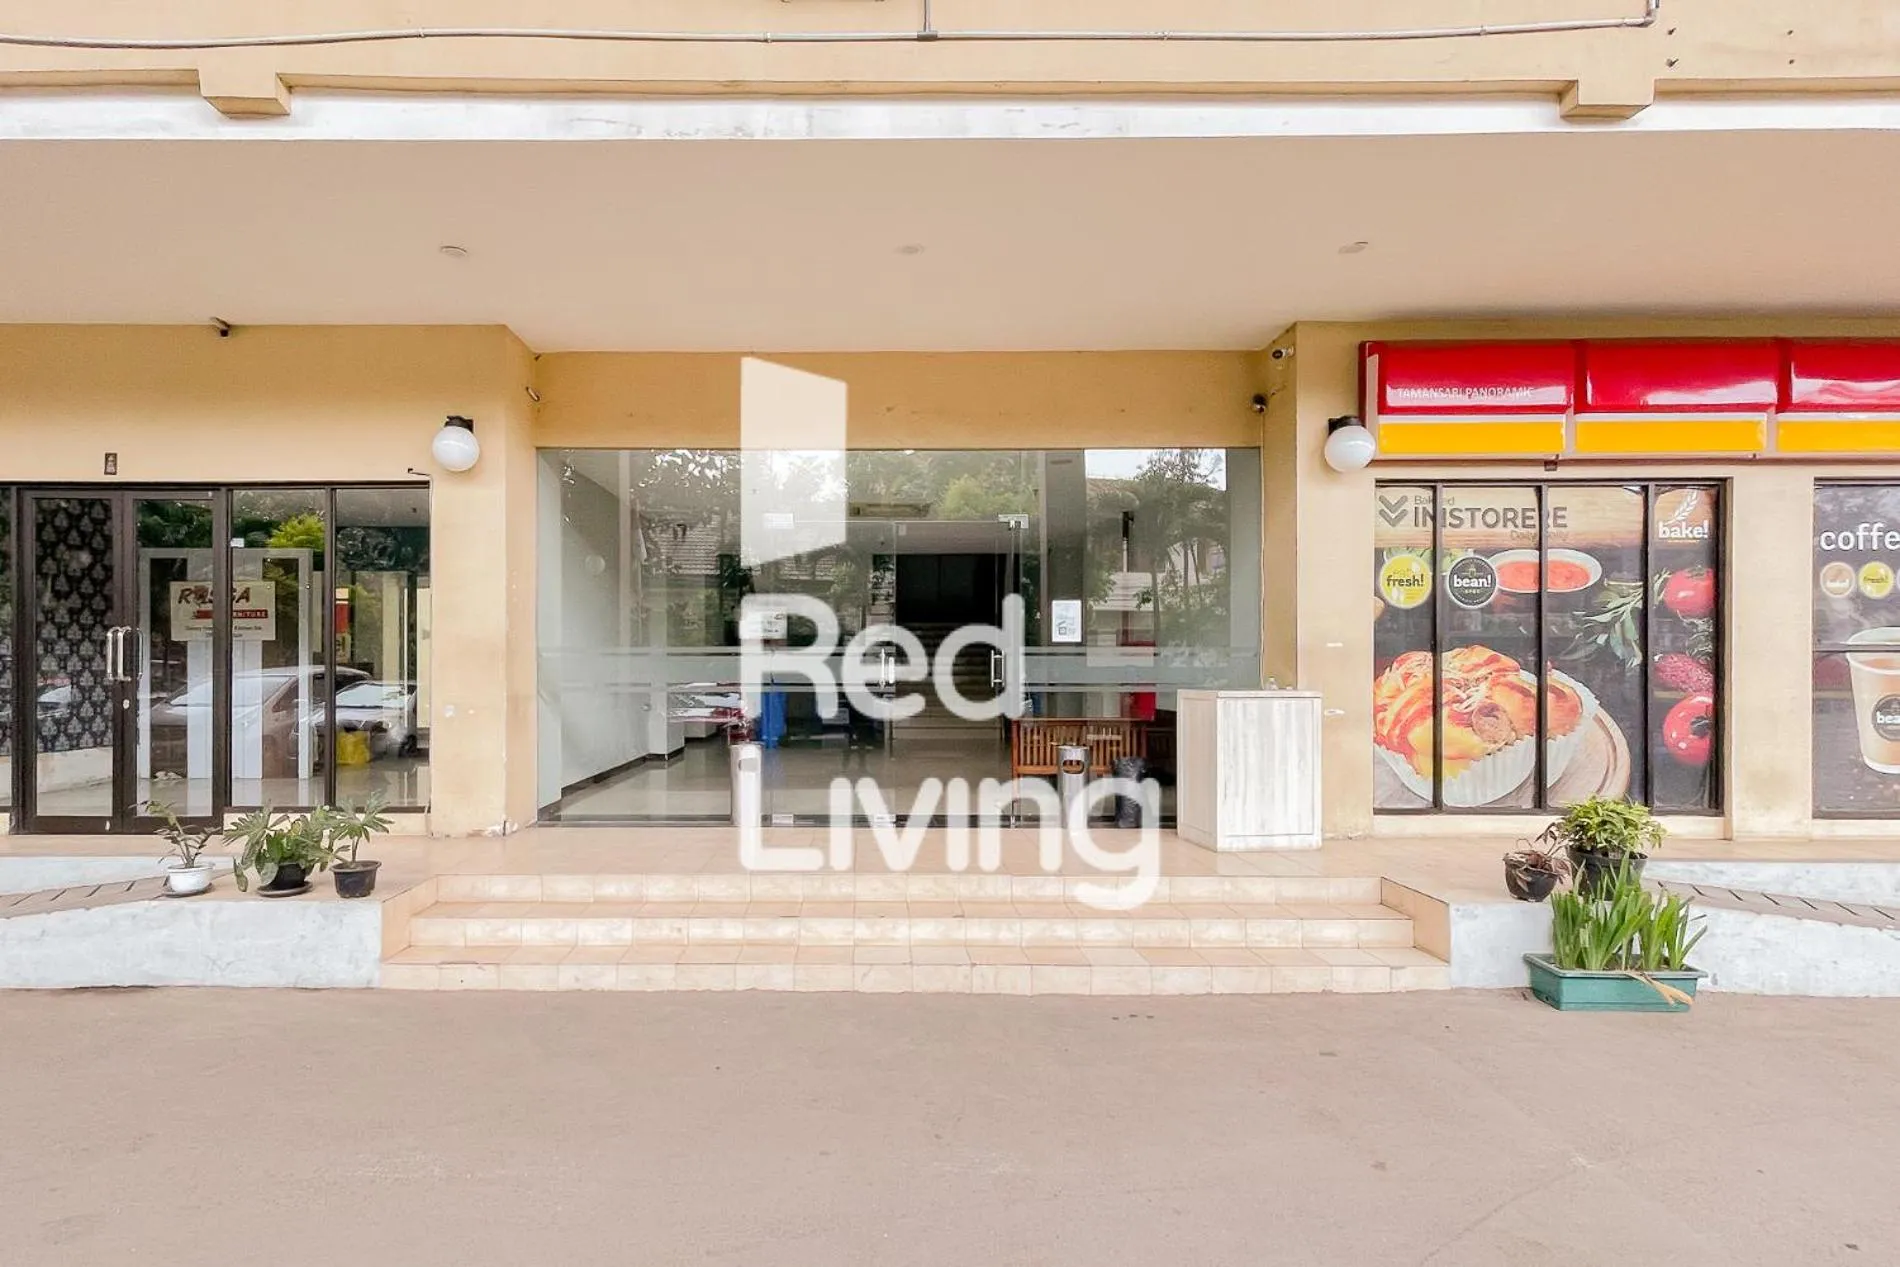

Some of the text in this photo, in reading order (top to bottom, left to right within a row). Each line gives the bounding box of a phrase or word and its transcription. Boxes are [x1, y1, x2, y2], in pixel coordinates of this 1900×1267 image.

[1658, 520, 1709, 539] bake!
[1820, 522, 1900, 551] coffe
[1386, 573, 1424, 587] fresh!
[1453, 574, 1492, 588] bean!
